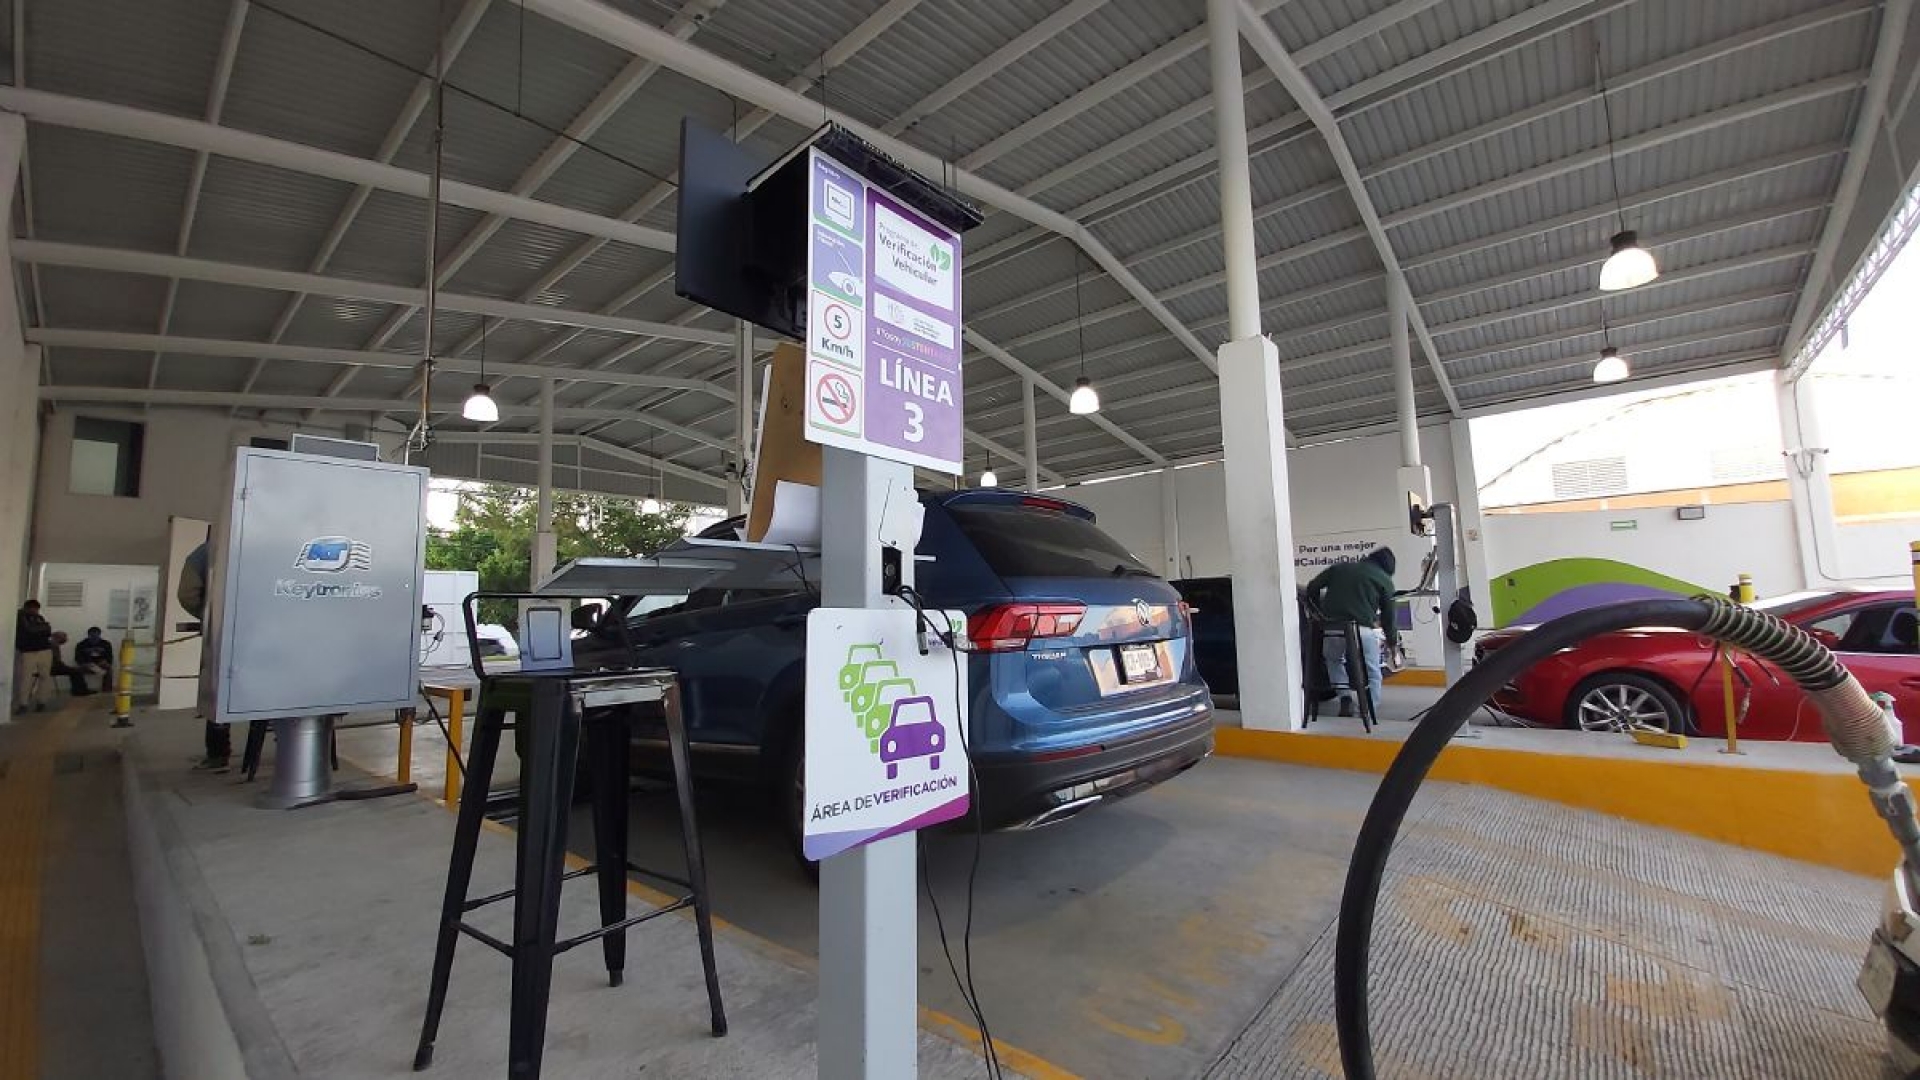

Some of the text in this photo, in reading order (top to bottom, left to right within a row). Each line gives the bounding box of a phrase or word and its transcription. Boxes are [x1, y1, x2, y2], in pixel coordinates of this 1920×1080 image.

[879, 232, 937, 273] Verificación
[892, 254, 938, 285] Vehicular
[833, 314, 843, 329] 5
[821, 336, 854, 359] Km/h
[879, 357, 955, 408] LÍNEA
[903, 401, 924, 443] 3
[1298, 540, 1377, 554] Por una mejor
[1294, 554, 1370, 567] #CalidadDelA
[810, 800, 852, 822] ÁREA
